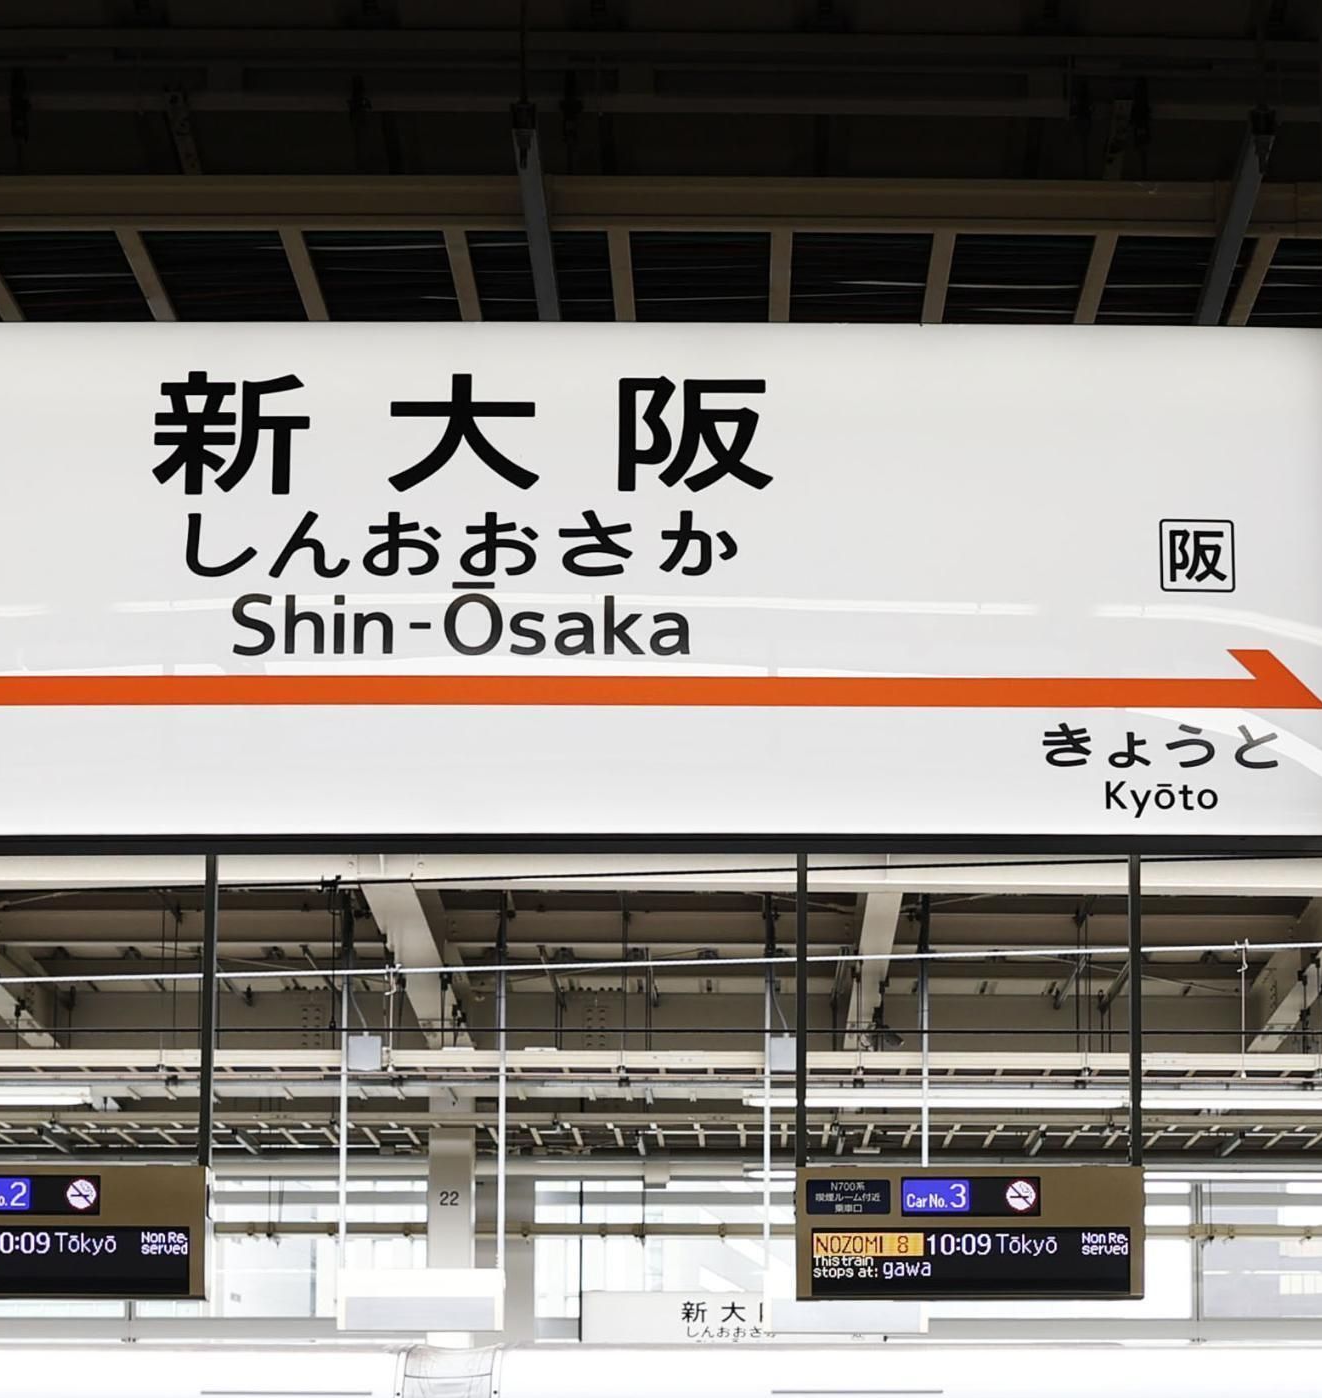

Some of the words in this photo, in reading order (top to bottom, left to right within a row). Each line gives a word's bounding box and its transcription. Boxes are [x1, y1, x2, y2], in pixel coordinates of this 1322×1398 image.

[152, 370, 776, 495] 新大阪
[180, 511, 741, 580] しんおおさか
[1165, 525, 1230, 588] 阪
[230, 578, 692, 657] Shin-Ōsaka
[1039, 720, 1281, 773] きょうと
[1101, 780, 1220, 820] Kyōto
[10, 1181, 27, 1206] 2
[439, 1191, 459, 1206] 22
[906, 1193, 928, 1208] Car
[950, 1183, 967, 1208] 3
[55, 1231, 117, 1256] Tōkyō
[141, 1231, 165, 1243] Non
[141, 1243, 188, 1255] served
[815, 1235, 883, 1254] NOZOMI
[897, 1235, 909, 1254] 8
[927, 1234, 992, 1256] 10:09
[996, 1233, 1058, 1257] Tōkyō
[1081, 1232, 1105, 1244] Non
[1081, 1244, 1129, 1256] served
[813, 1266, 854, 1279] stops
[858, 1267, 878, 1278] at:
[882, 1261, 932, 1280] gawa
[681, 1301, 764, 1323] 新大
